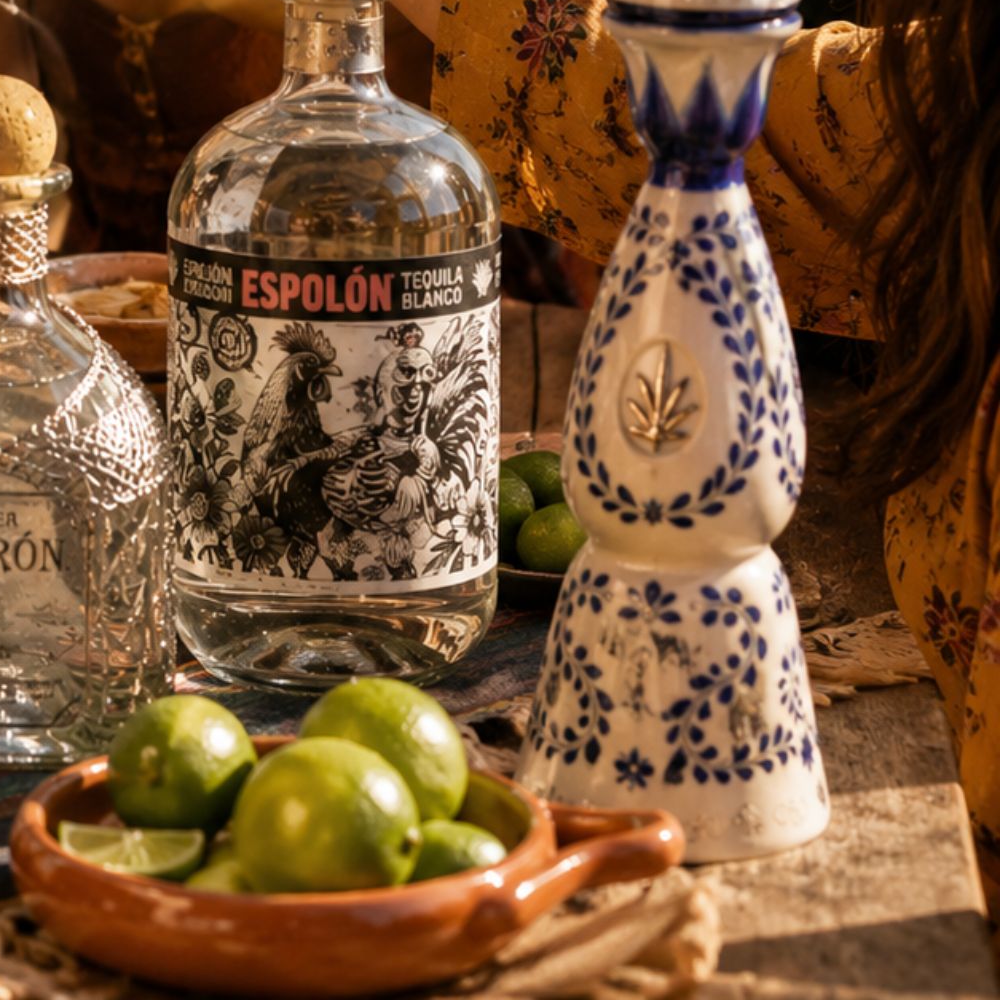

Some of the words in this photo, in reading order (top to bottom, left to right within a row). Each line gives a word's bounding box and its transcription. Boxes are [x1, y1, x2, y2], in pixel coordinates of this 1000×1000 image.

[241, 265, 392, 313] ESPOLÓN
[400, 265, 464, 290] TEQUILA
[401, 286, 463, 310] BLANCO
